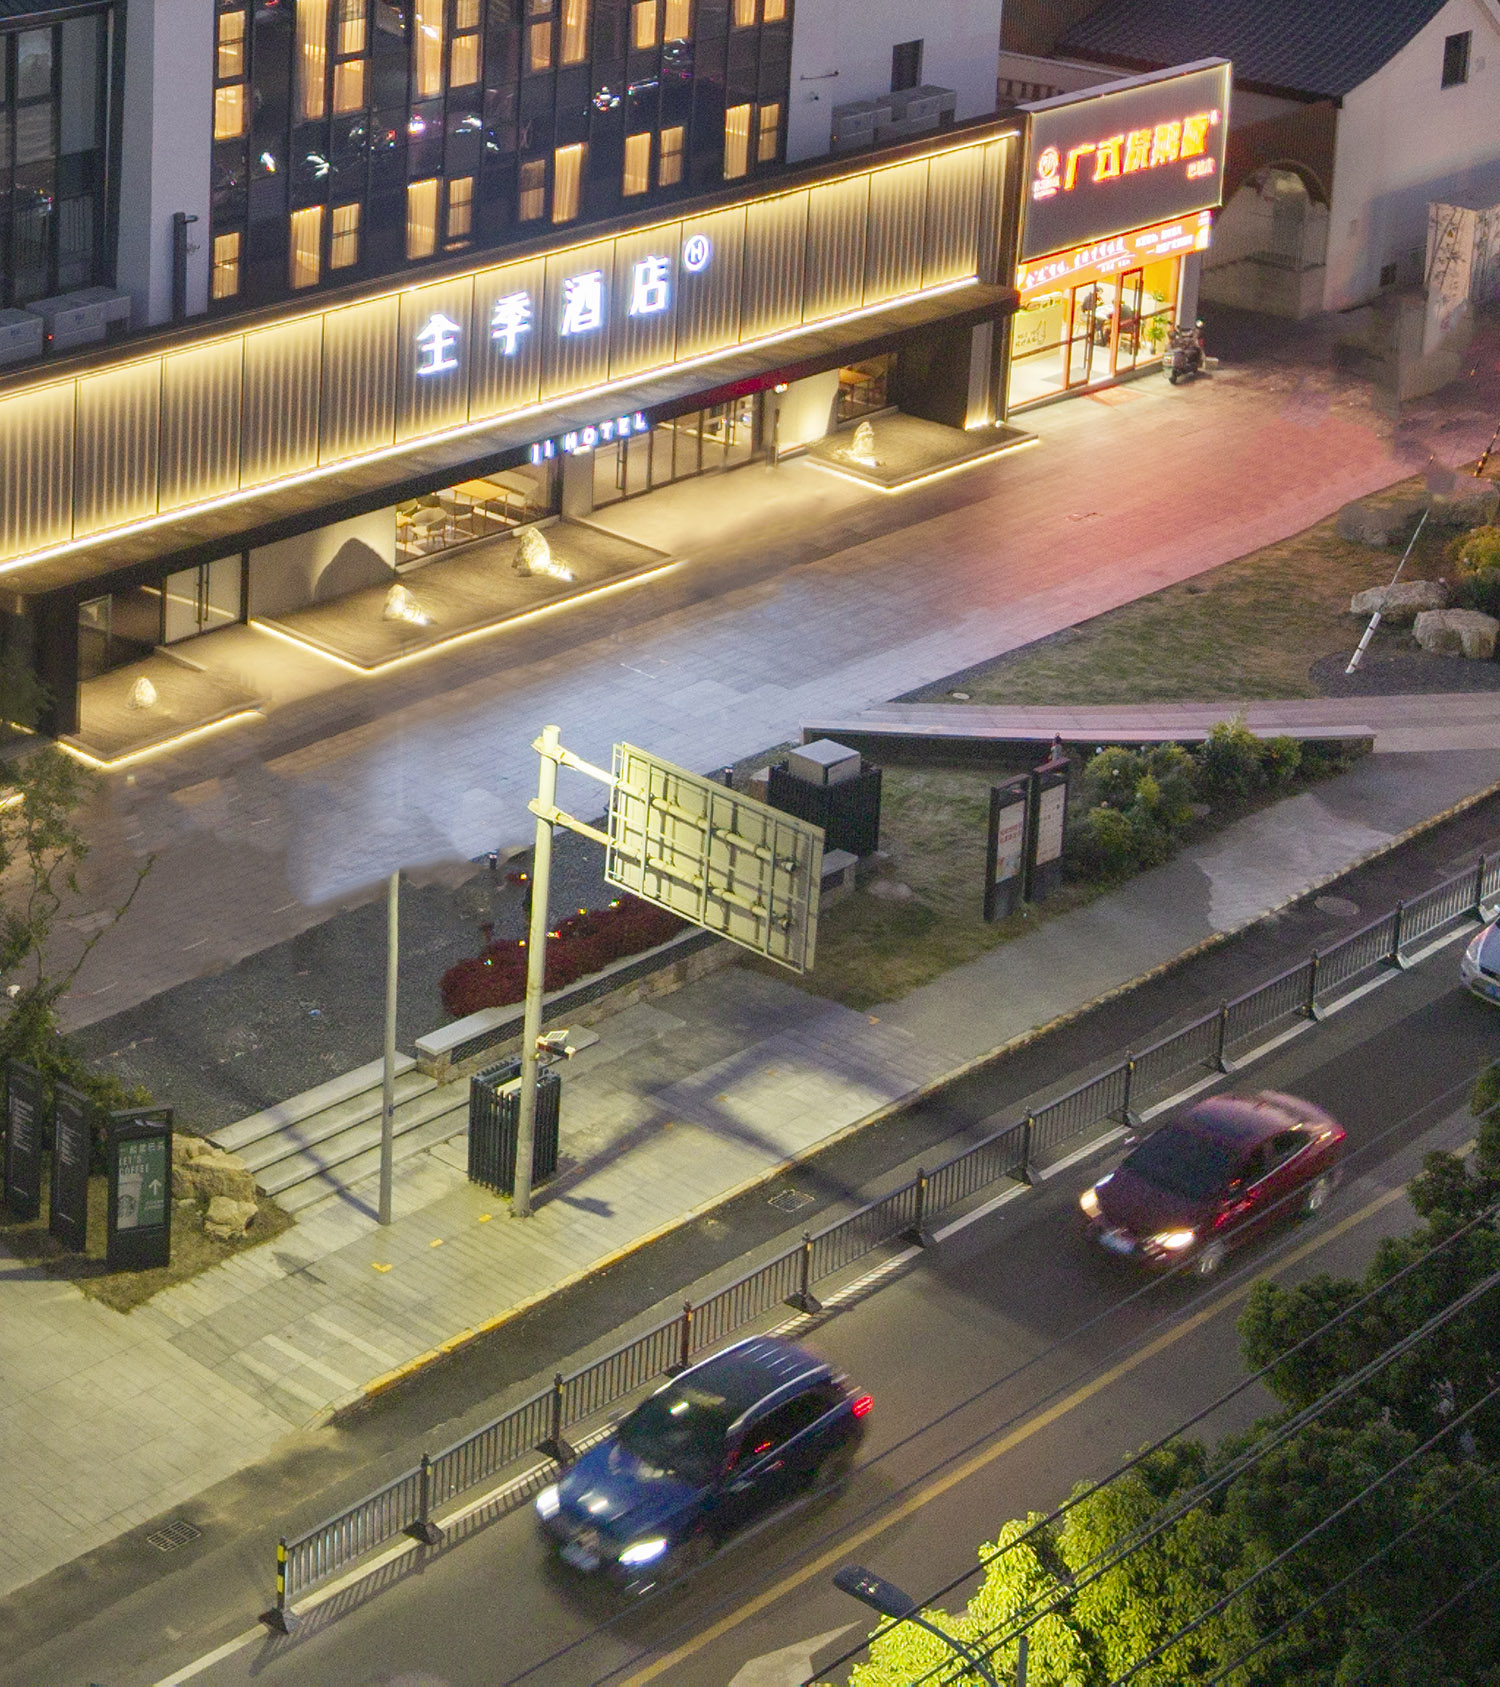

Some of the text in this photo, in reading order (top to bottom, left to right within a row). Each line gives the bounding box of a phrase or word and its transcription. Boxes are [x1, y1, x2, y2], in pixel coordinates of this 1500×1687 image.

[416, 254, 672, 377] 全季酒店
[563, 411, 648, 452] HOTEL
